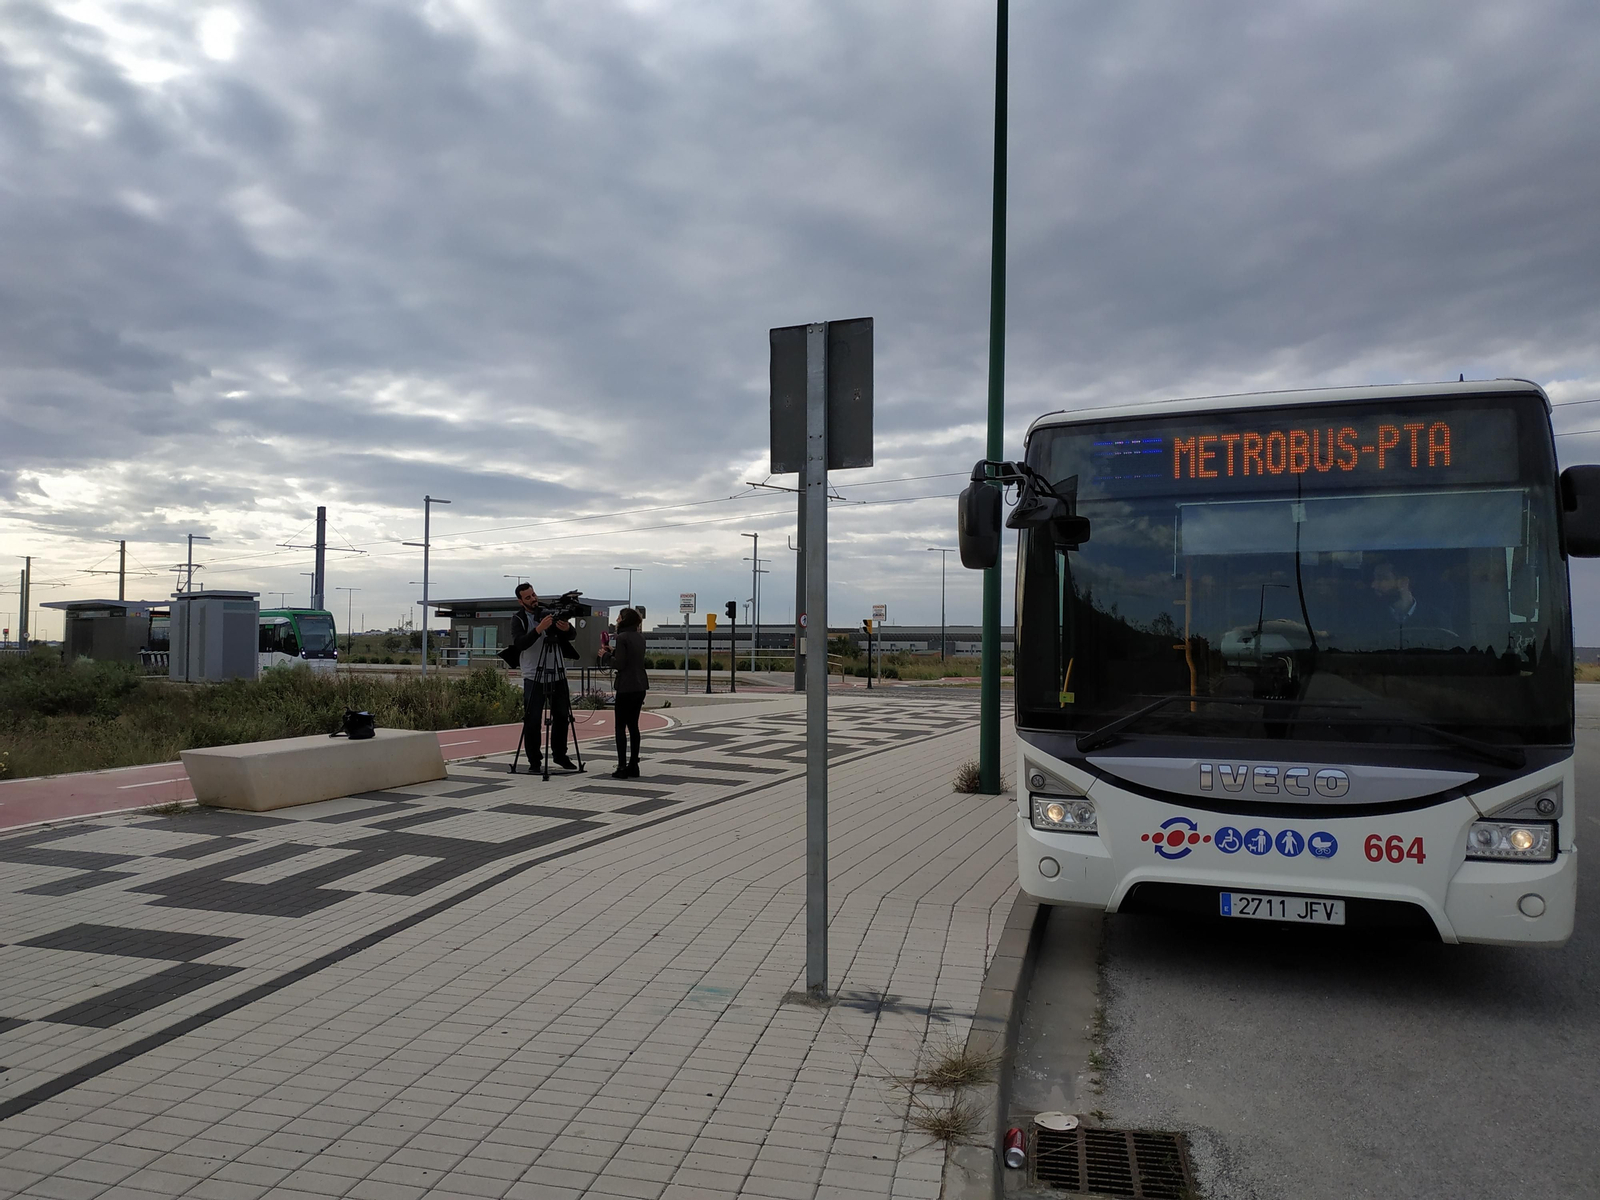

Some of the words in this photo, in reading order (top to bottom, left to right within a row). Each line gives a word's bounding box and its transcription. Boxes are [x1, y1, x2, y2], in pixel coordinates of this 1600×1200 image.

[1173, 421, 1450, 479] METROBUS-PTA
[1200, 763, 1350, 797] IVECO
[1364, 833, 1426, 864] 664
[1239, 897, 1286, 917] 2711
[1297, 901, 1334, 921] JFV
